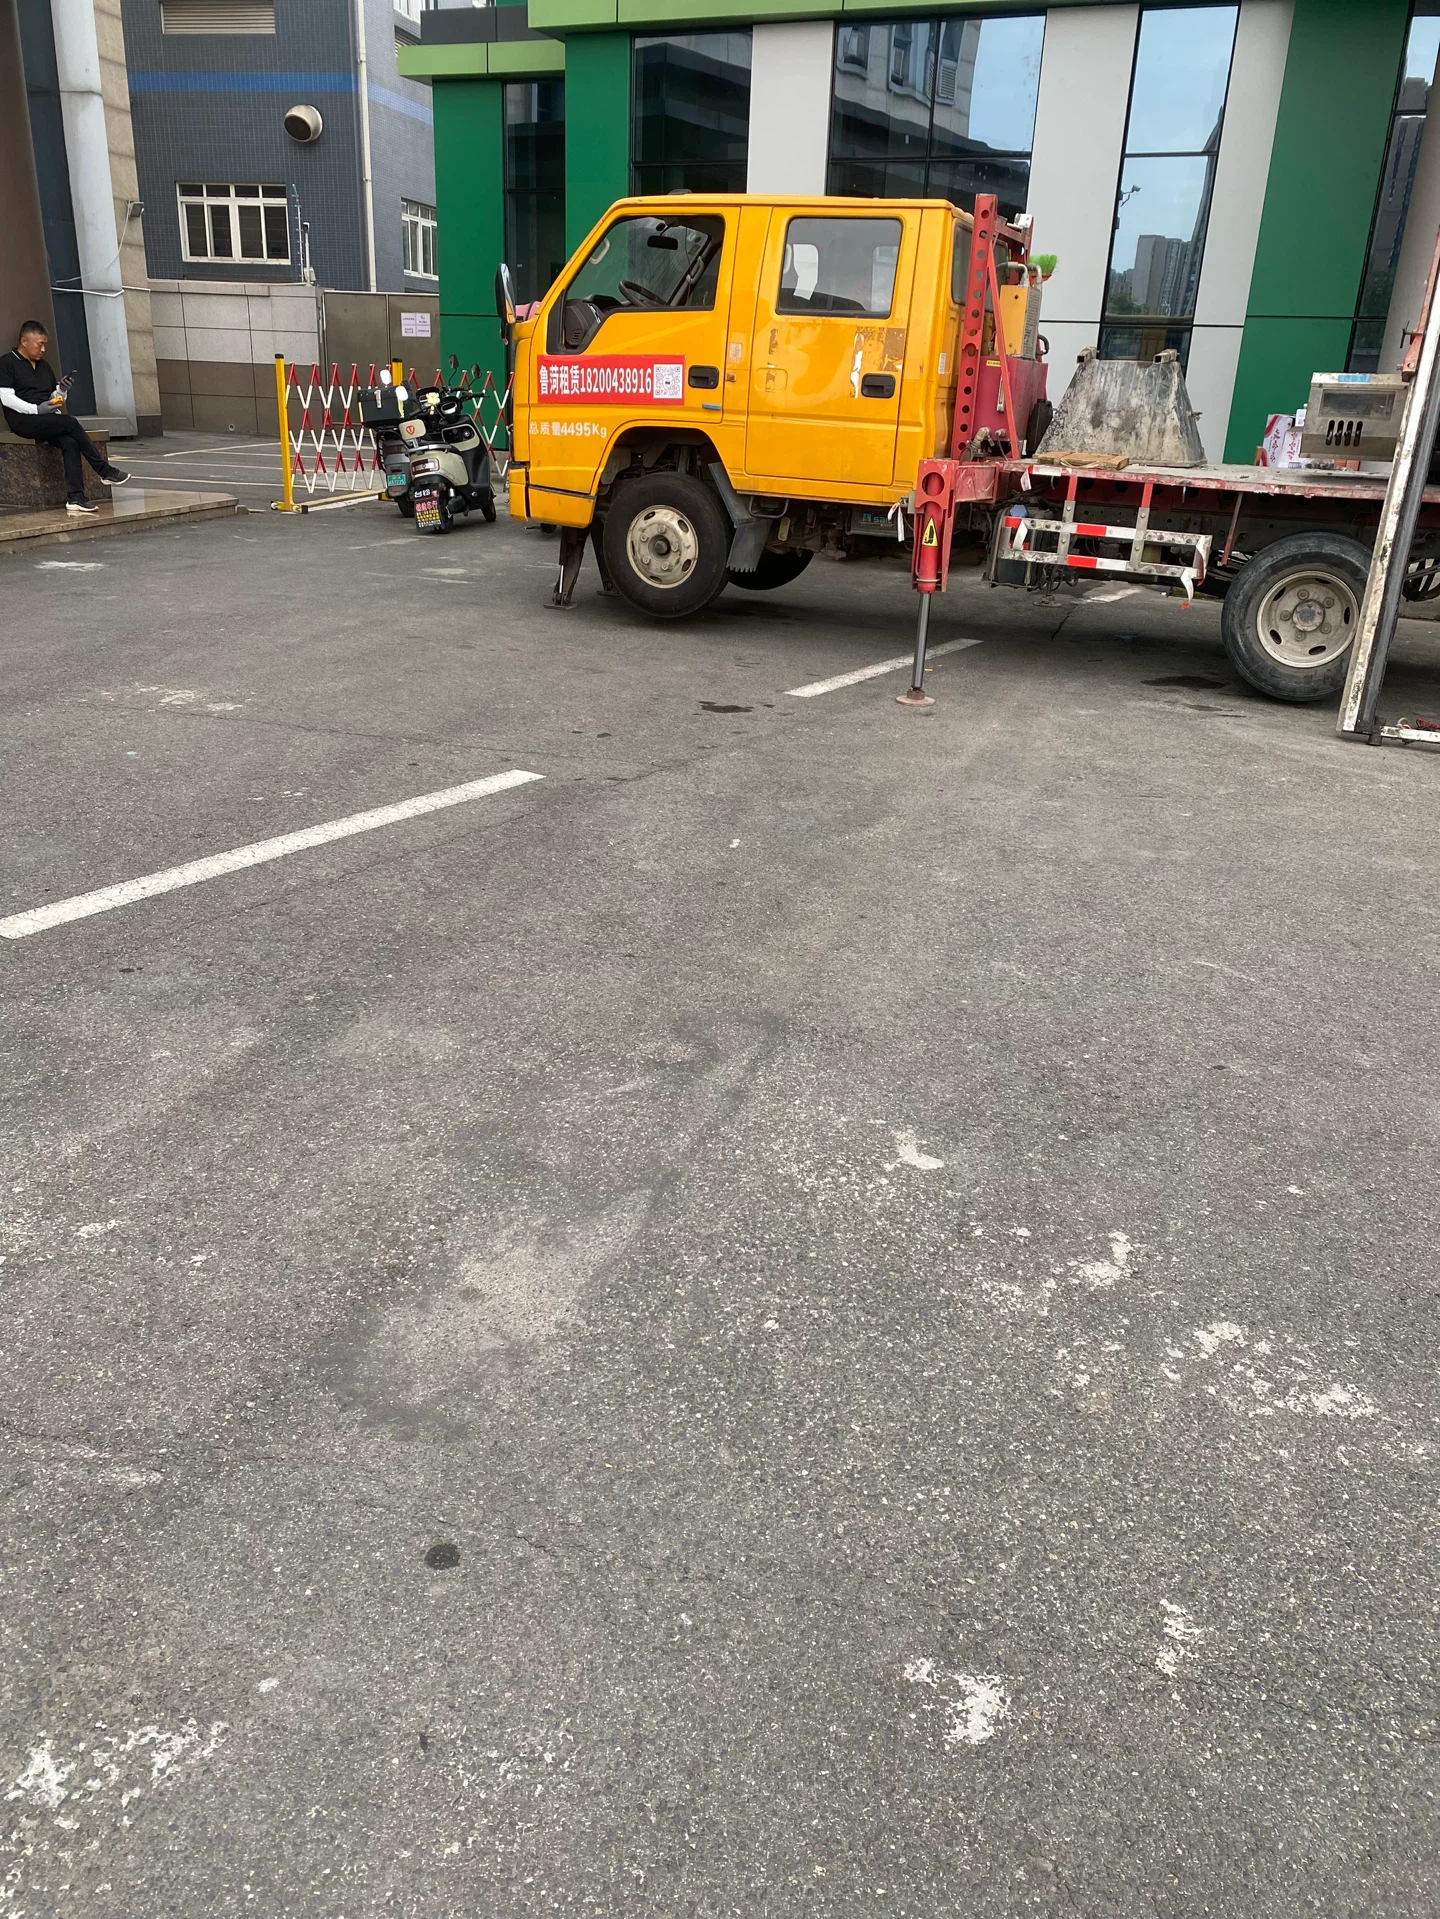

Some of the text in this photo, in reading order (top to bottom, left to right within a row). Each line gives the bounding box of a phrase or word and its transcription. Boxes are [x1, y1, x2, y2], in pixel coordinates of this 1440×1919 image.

[539, 364, 652, 395] 鲁菏租赁18200438916
[529, 421, 607, 438] 总质量4495Kg
